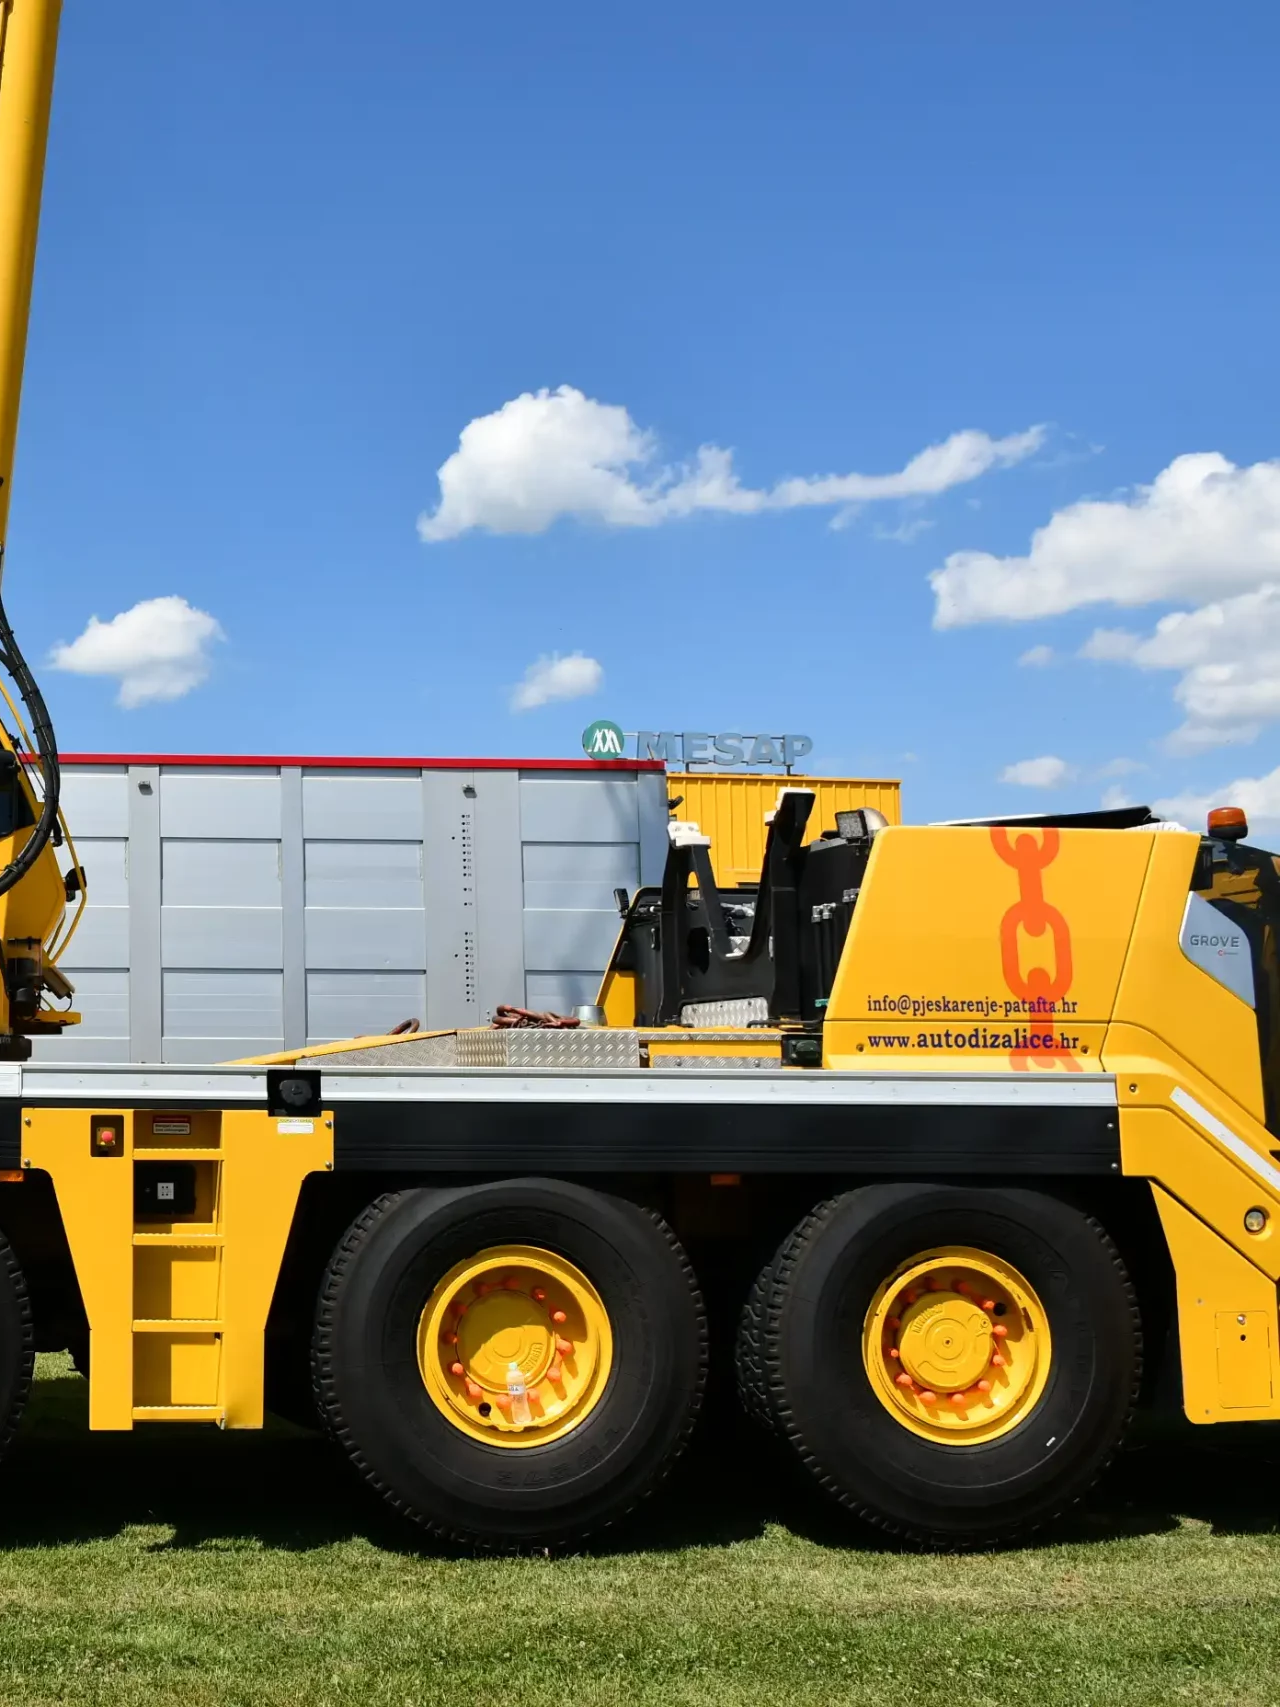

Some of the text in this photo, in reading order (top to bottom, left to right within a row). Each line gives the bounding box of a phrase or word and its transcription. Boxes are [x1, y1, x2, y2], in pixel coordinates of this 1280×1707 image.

[637, 731, 813, 766] MESAP
[1189, 934, 1240, 948] GROVE
[867, 994, 1078, 1017] info@pjeskarenje-patafta.hr
[867, 1028, 1080, 1049] www.autodizalice.hr
